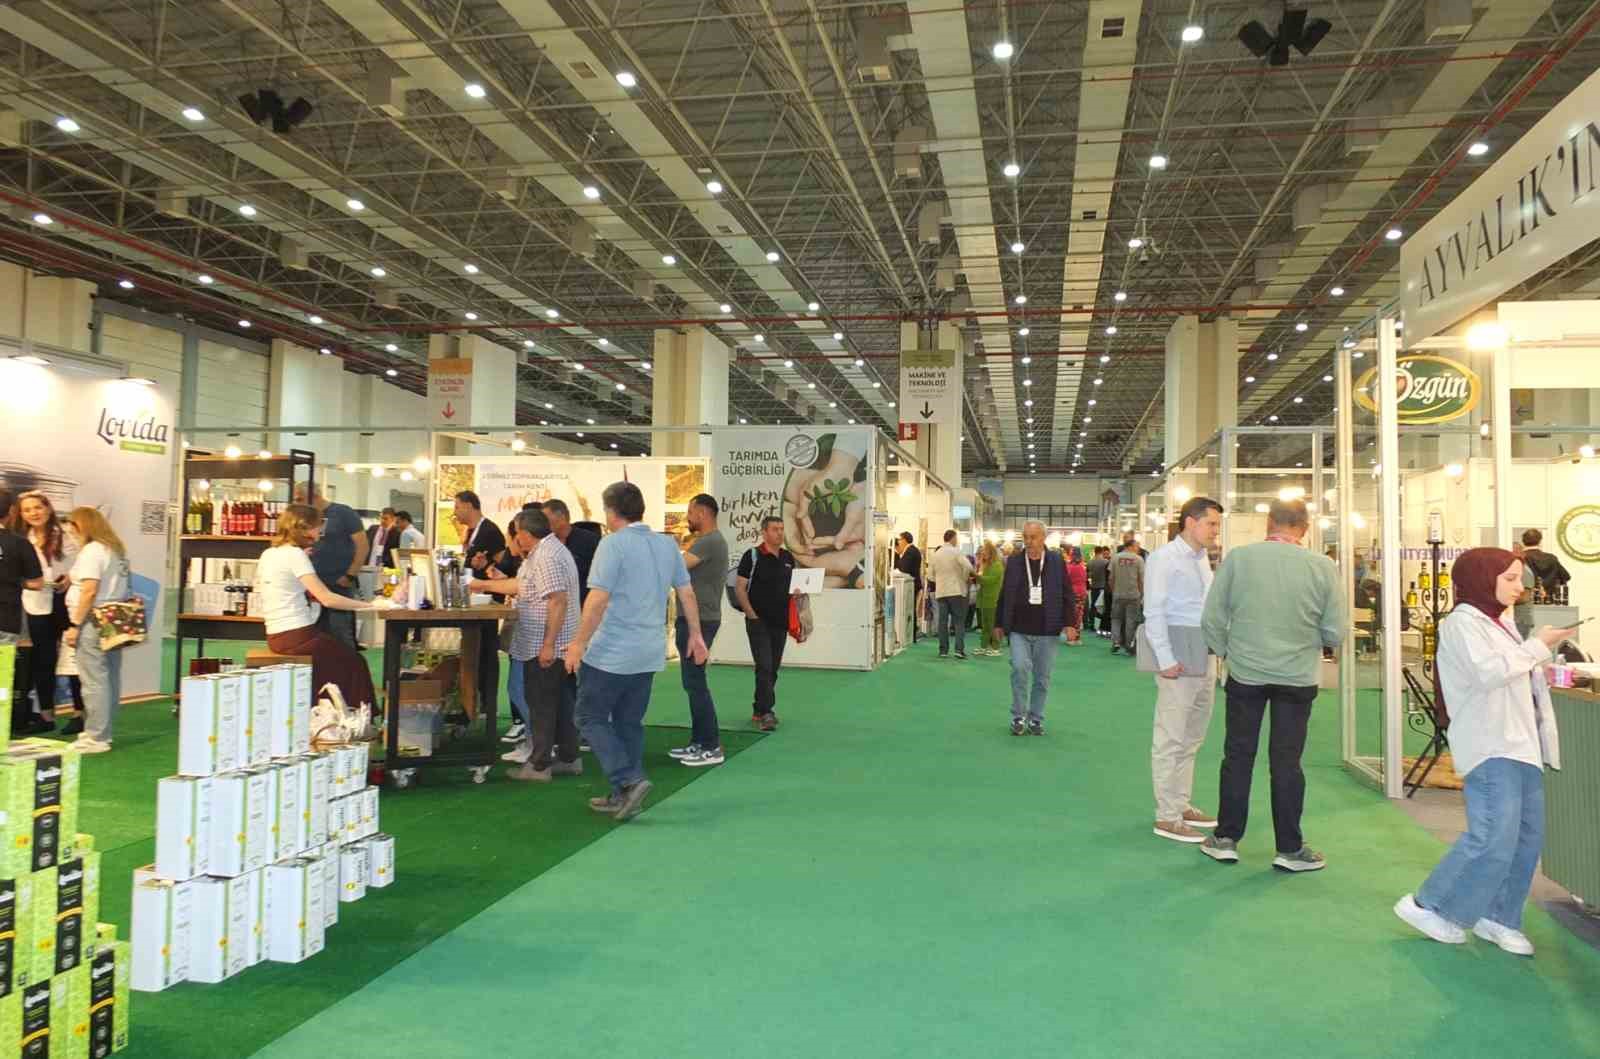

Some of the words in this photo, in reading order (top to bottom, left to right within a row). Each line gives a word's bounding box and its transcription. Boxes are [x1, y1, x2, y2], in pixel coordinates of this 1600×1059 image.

[97, 407, 168, 445] Lovida
[728, 451, 779, 461] TARIMDA
[721, 462, 785, 477] GÜÇBİRLİĞİ
